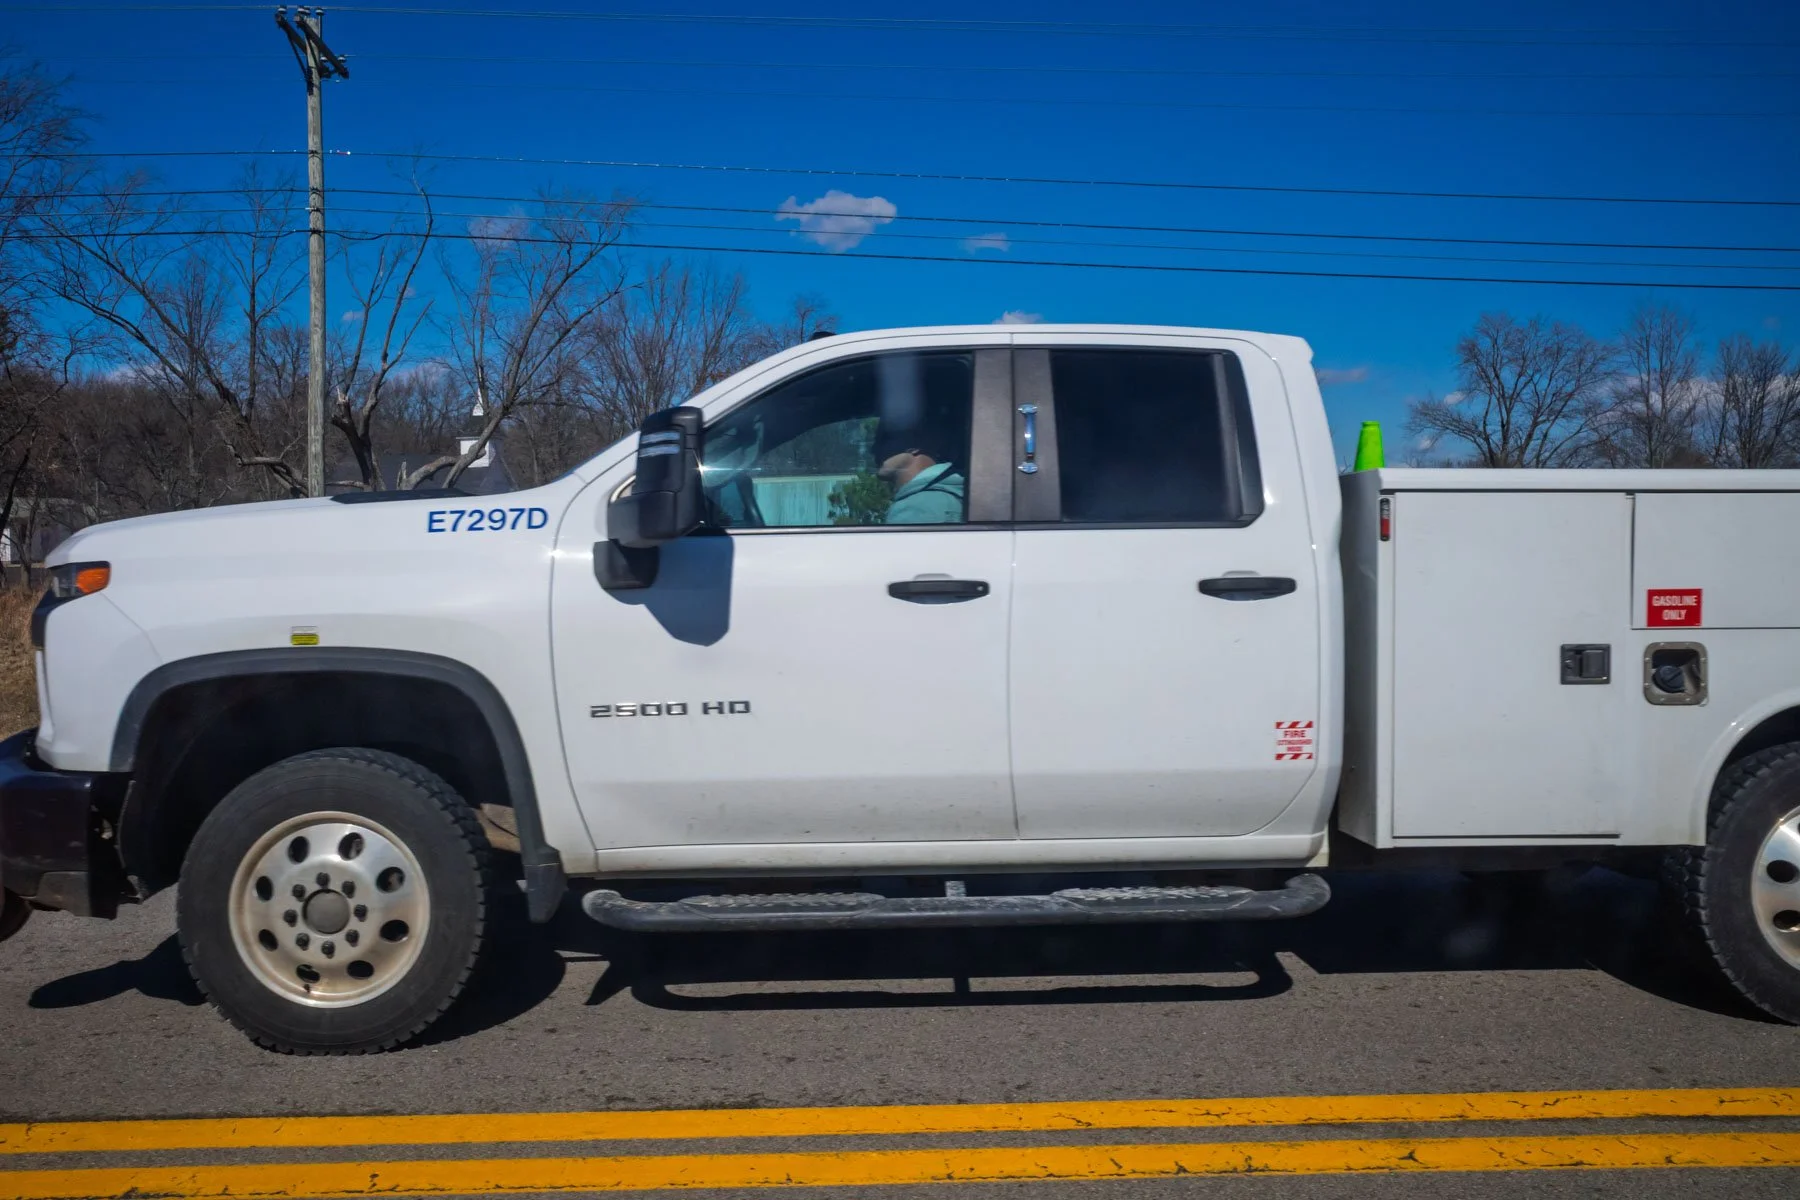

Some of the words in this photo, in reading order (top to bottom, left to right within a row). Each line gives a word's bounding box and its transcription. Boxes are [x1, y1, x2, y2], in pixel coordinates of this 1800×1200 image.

[427, 507, 549, 533] E7297D
[1652, 595, 1698, 607] GASOLINE
[1662, 609, 1687, 621] ONLY
[590, 701, 688, 718] 2500
[702, 700, 751, 715] HD
[1283, 729, 1306, 738] FIRE
